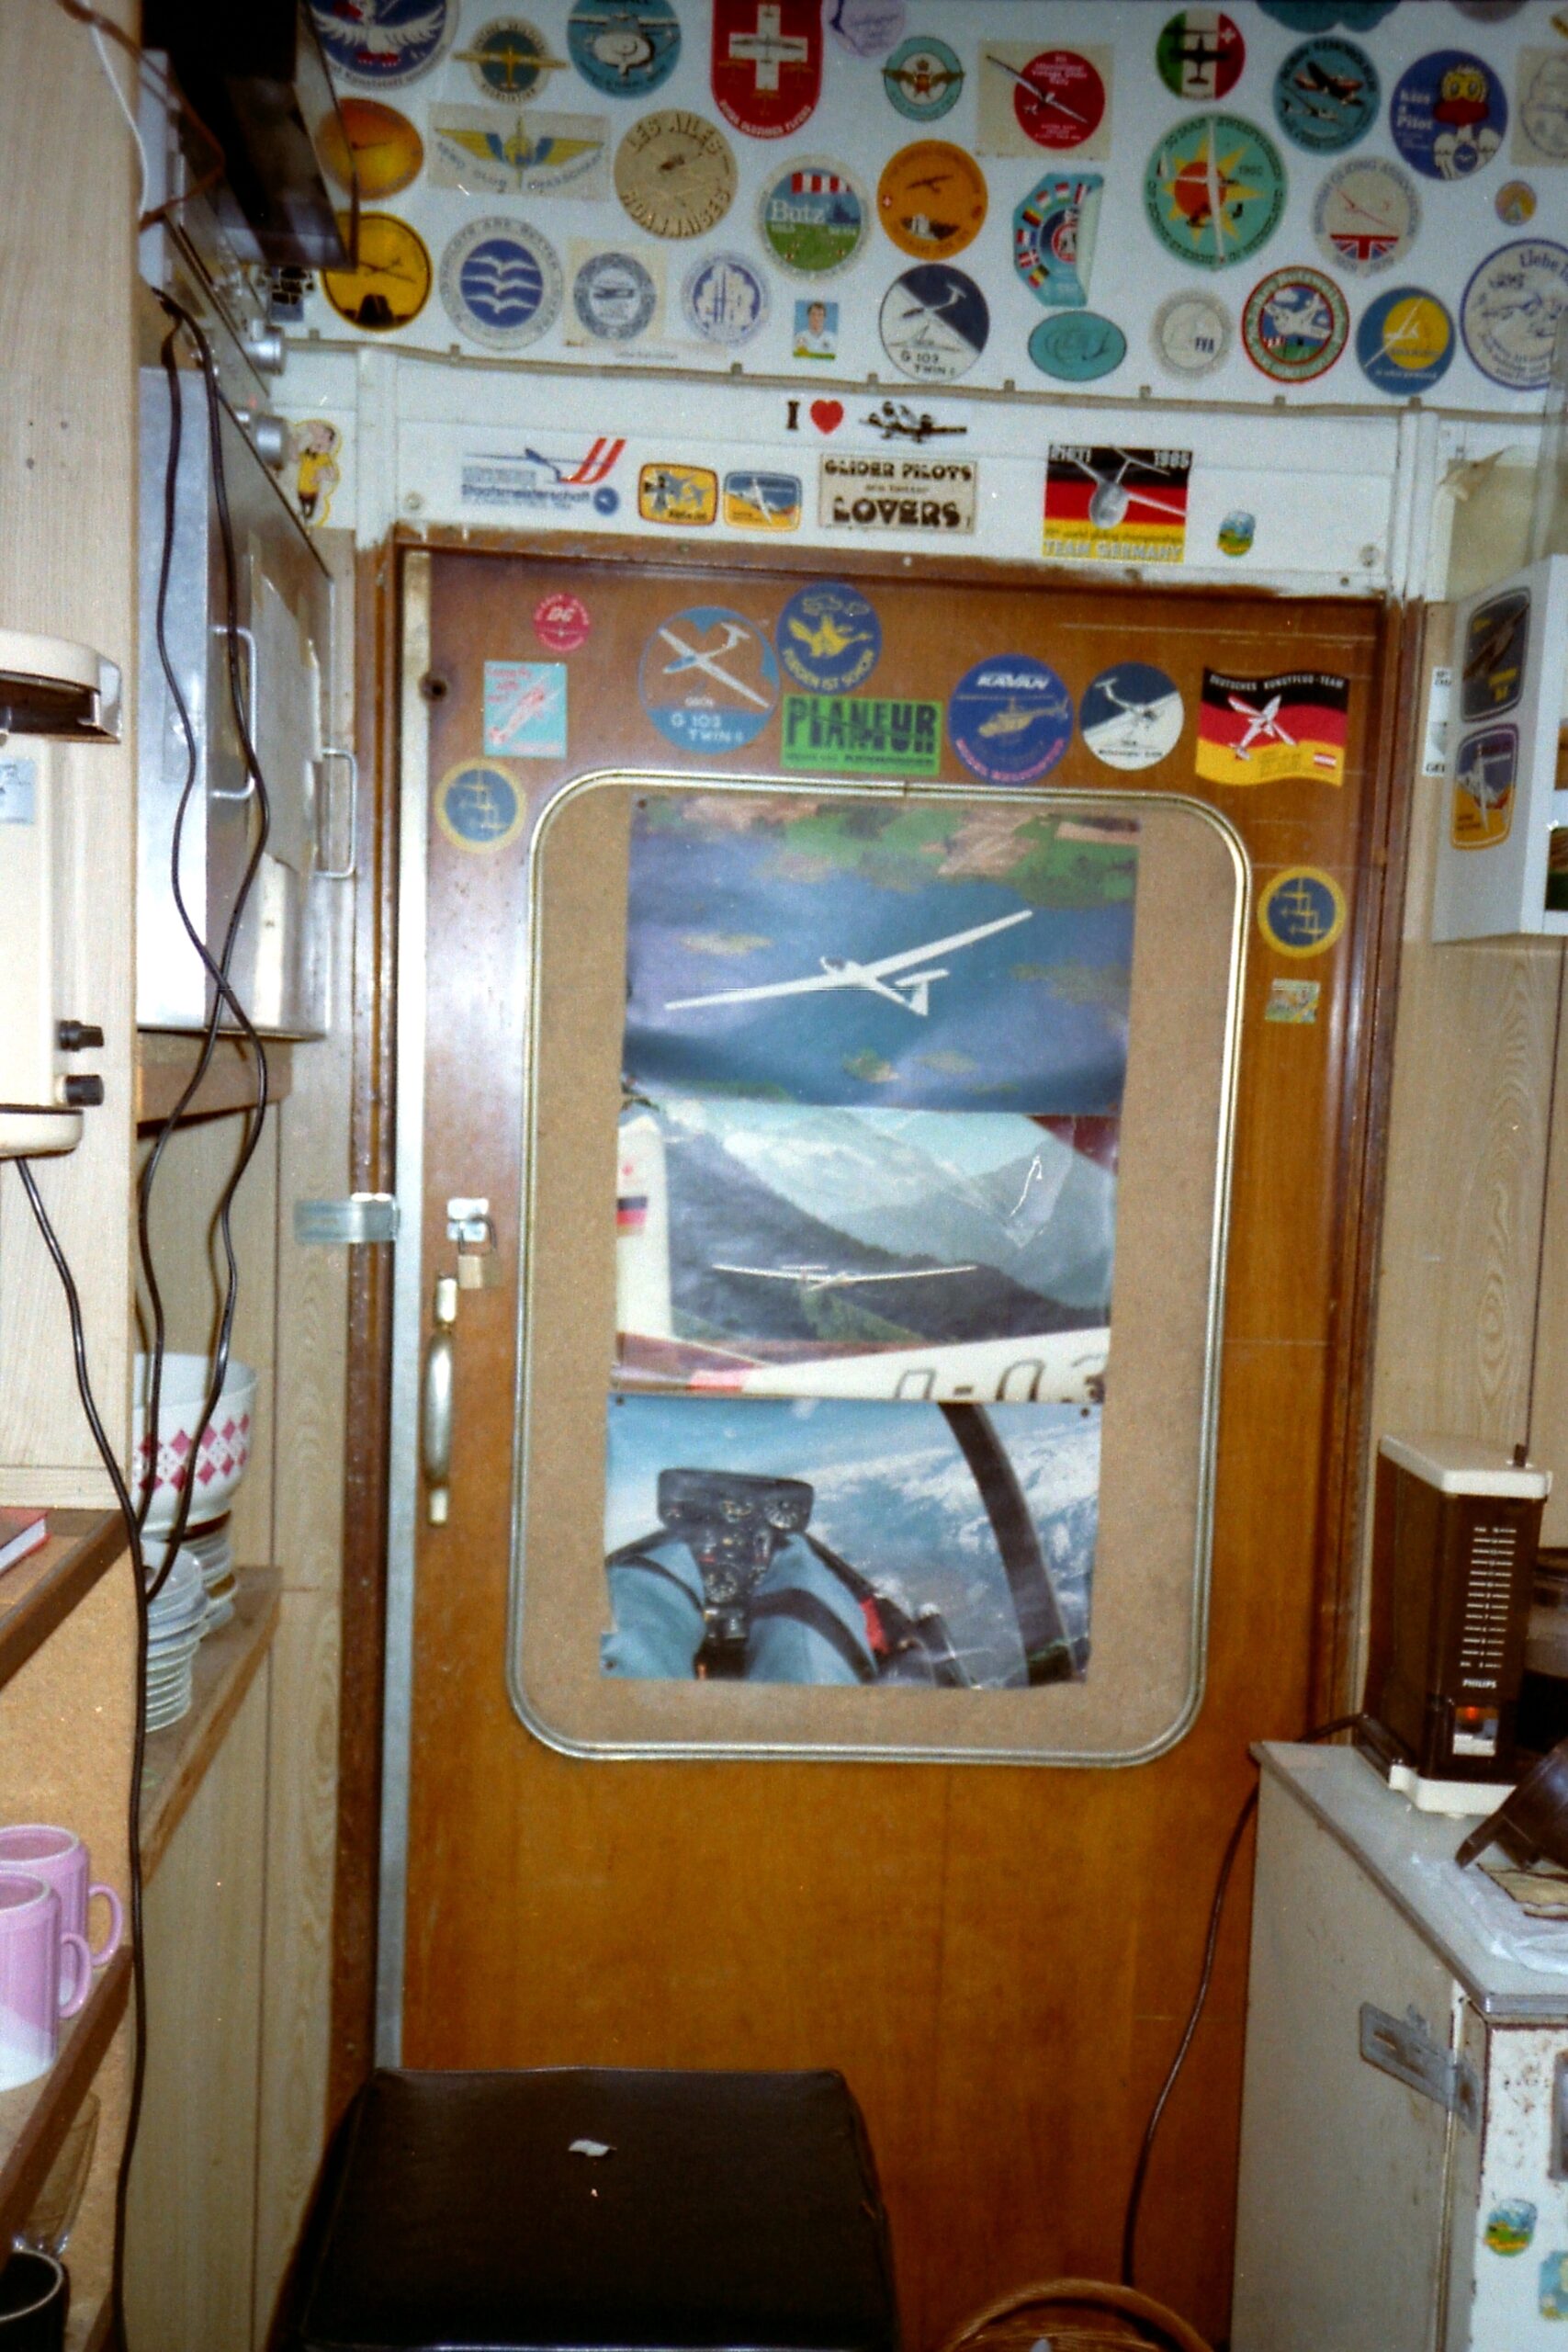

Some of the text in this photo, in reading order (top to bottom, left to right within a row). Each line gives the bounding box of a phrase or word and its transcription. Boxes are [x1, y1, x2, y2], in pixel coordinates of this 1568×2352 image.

[824, 459, 972, 481] GLIDER PILOTS
[1044, 539, 1183, 563] TEAM GERMANY
[1209, 674, 1258, 691] DEUTSCHES
[785, 694, 938, 754] PLANEUR
[1462, 1678, 1497, 1689] PHILIPS
